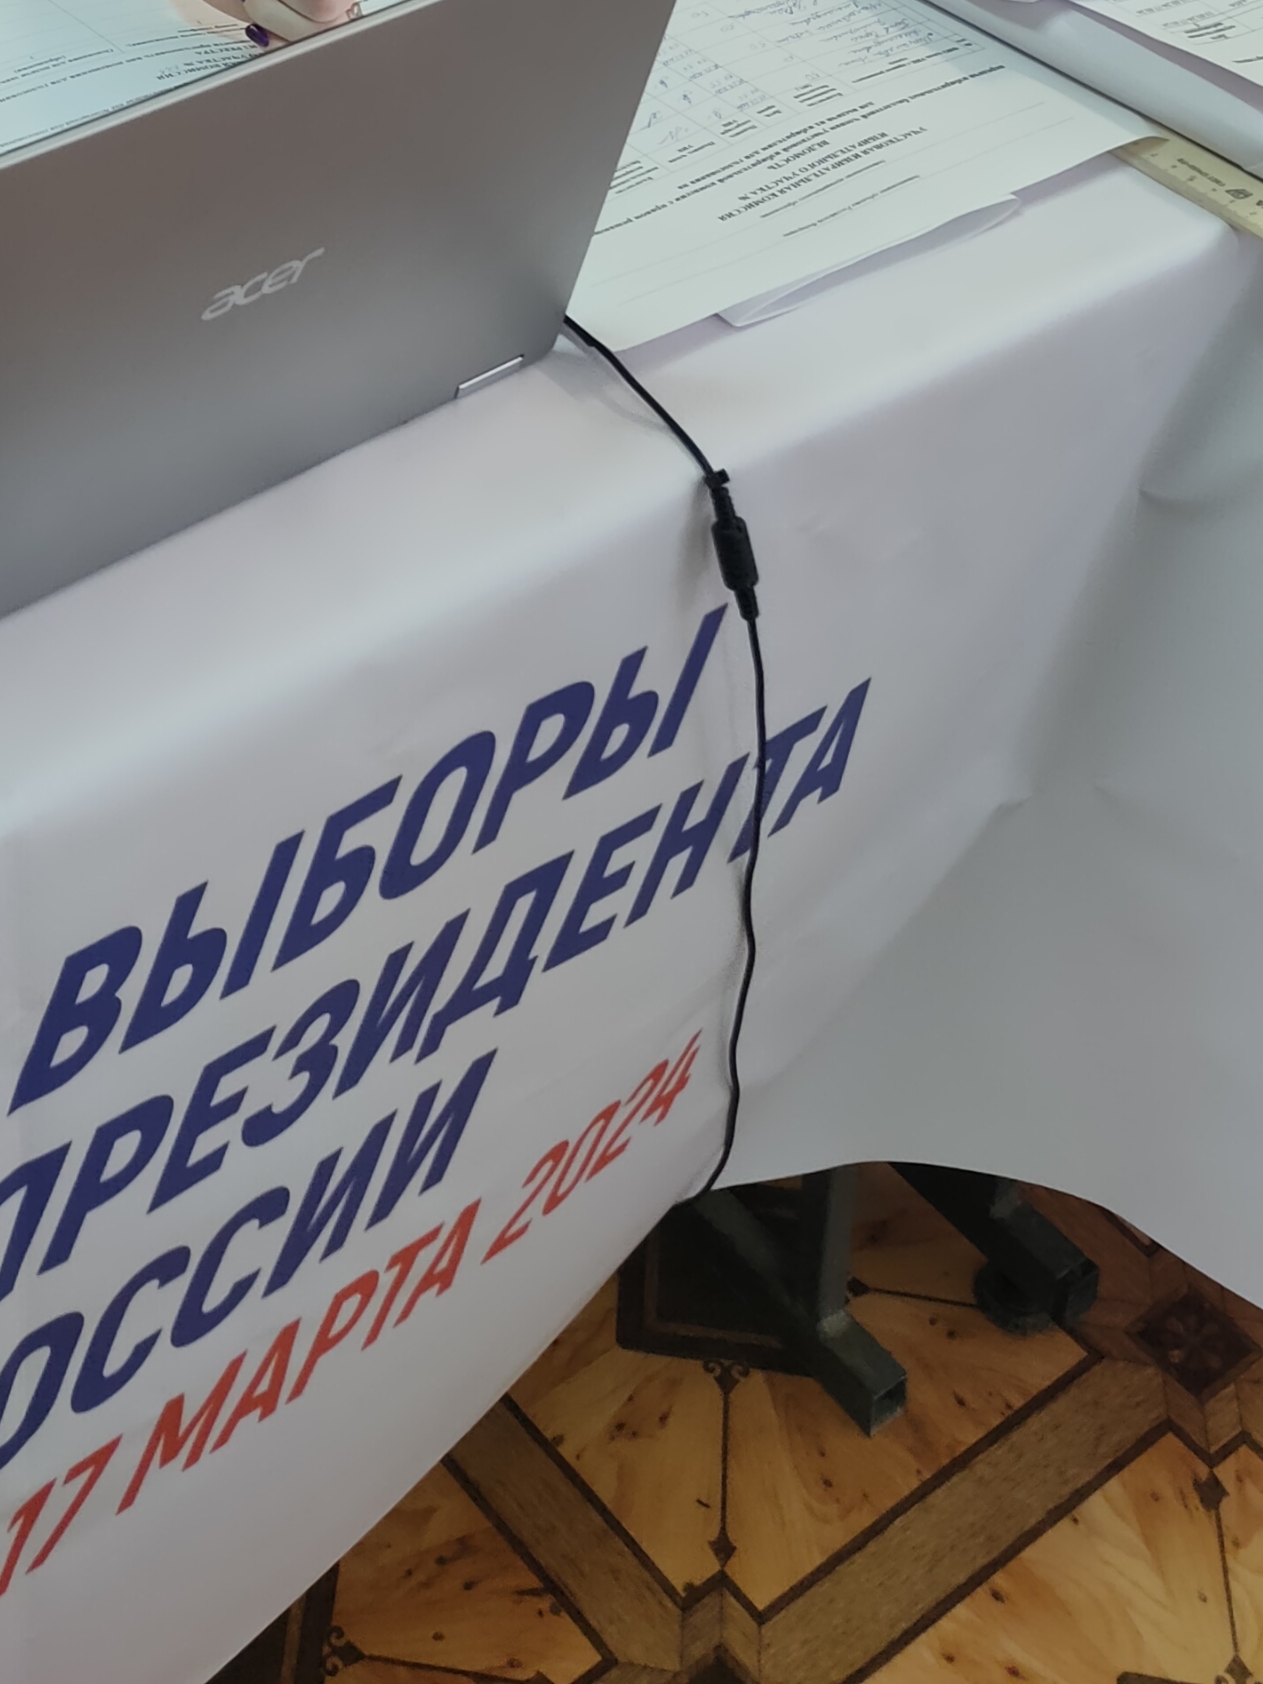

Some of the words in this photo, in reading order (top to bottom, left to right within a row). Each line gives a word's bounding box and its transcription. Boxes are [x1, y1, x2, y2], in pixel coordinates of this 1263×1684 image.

[765, 137, 830, 173] ВЕДОМОСТЬ
[797, 129, 888, 174] ИЗБИРАТЕЛЬНОГО
[859, 123, 928, 157] УЧАСТКОВАЯ
[746, 170, 797, 199] УЧАСТКА
[776, 151, 862, 196] ИЗБИРАТЕЛЬНАЯ
[716, 189, 780, 223] КОМИССИЯ
[201, 246, 325, 321] acer
[7, 603, 728, 1114] ВЫБОРЫ
[116, 1197, 482, 1514] МАРТА
[480, 1028, 703, 1265] 2024
